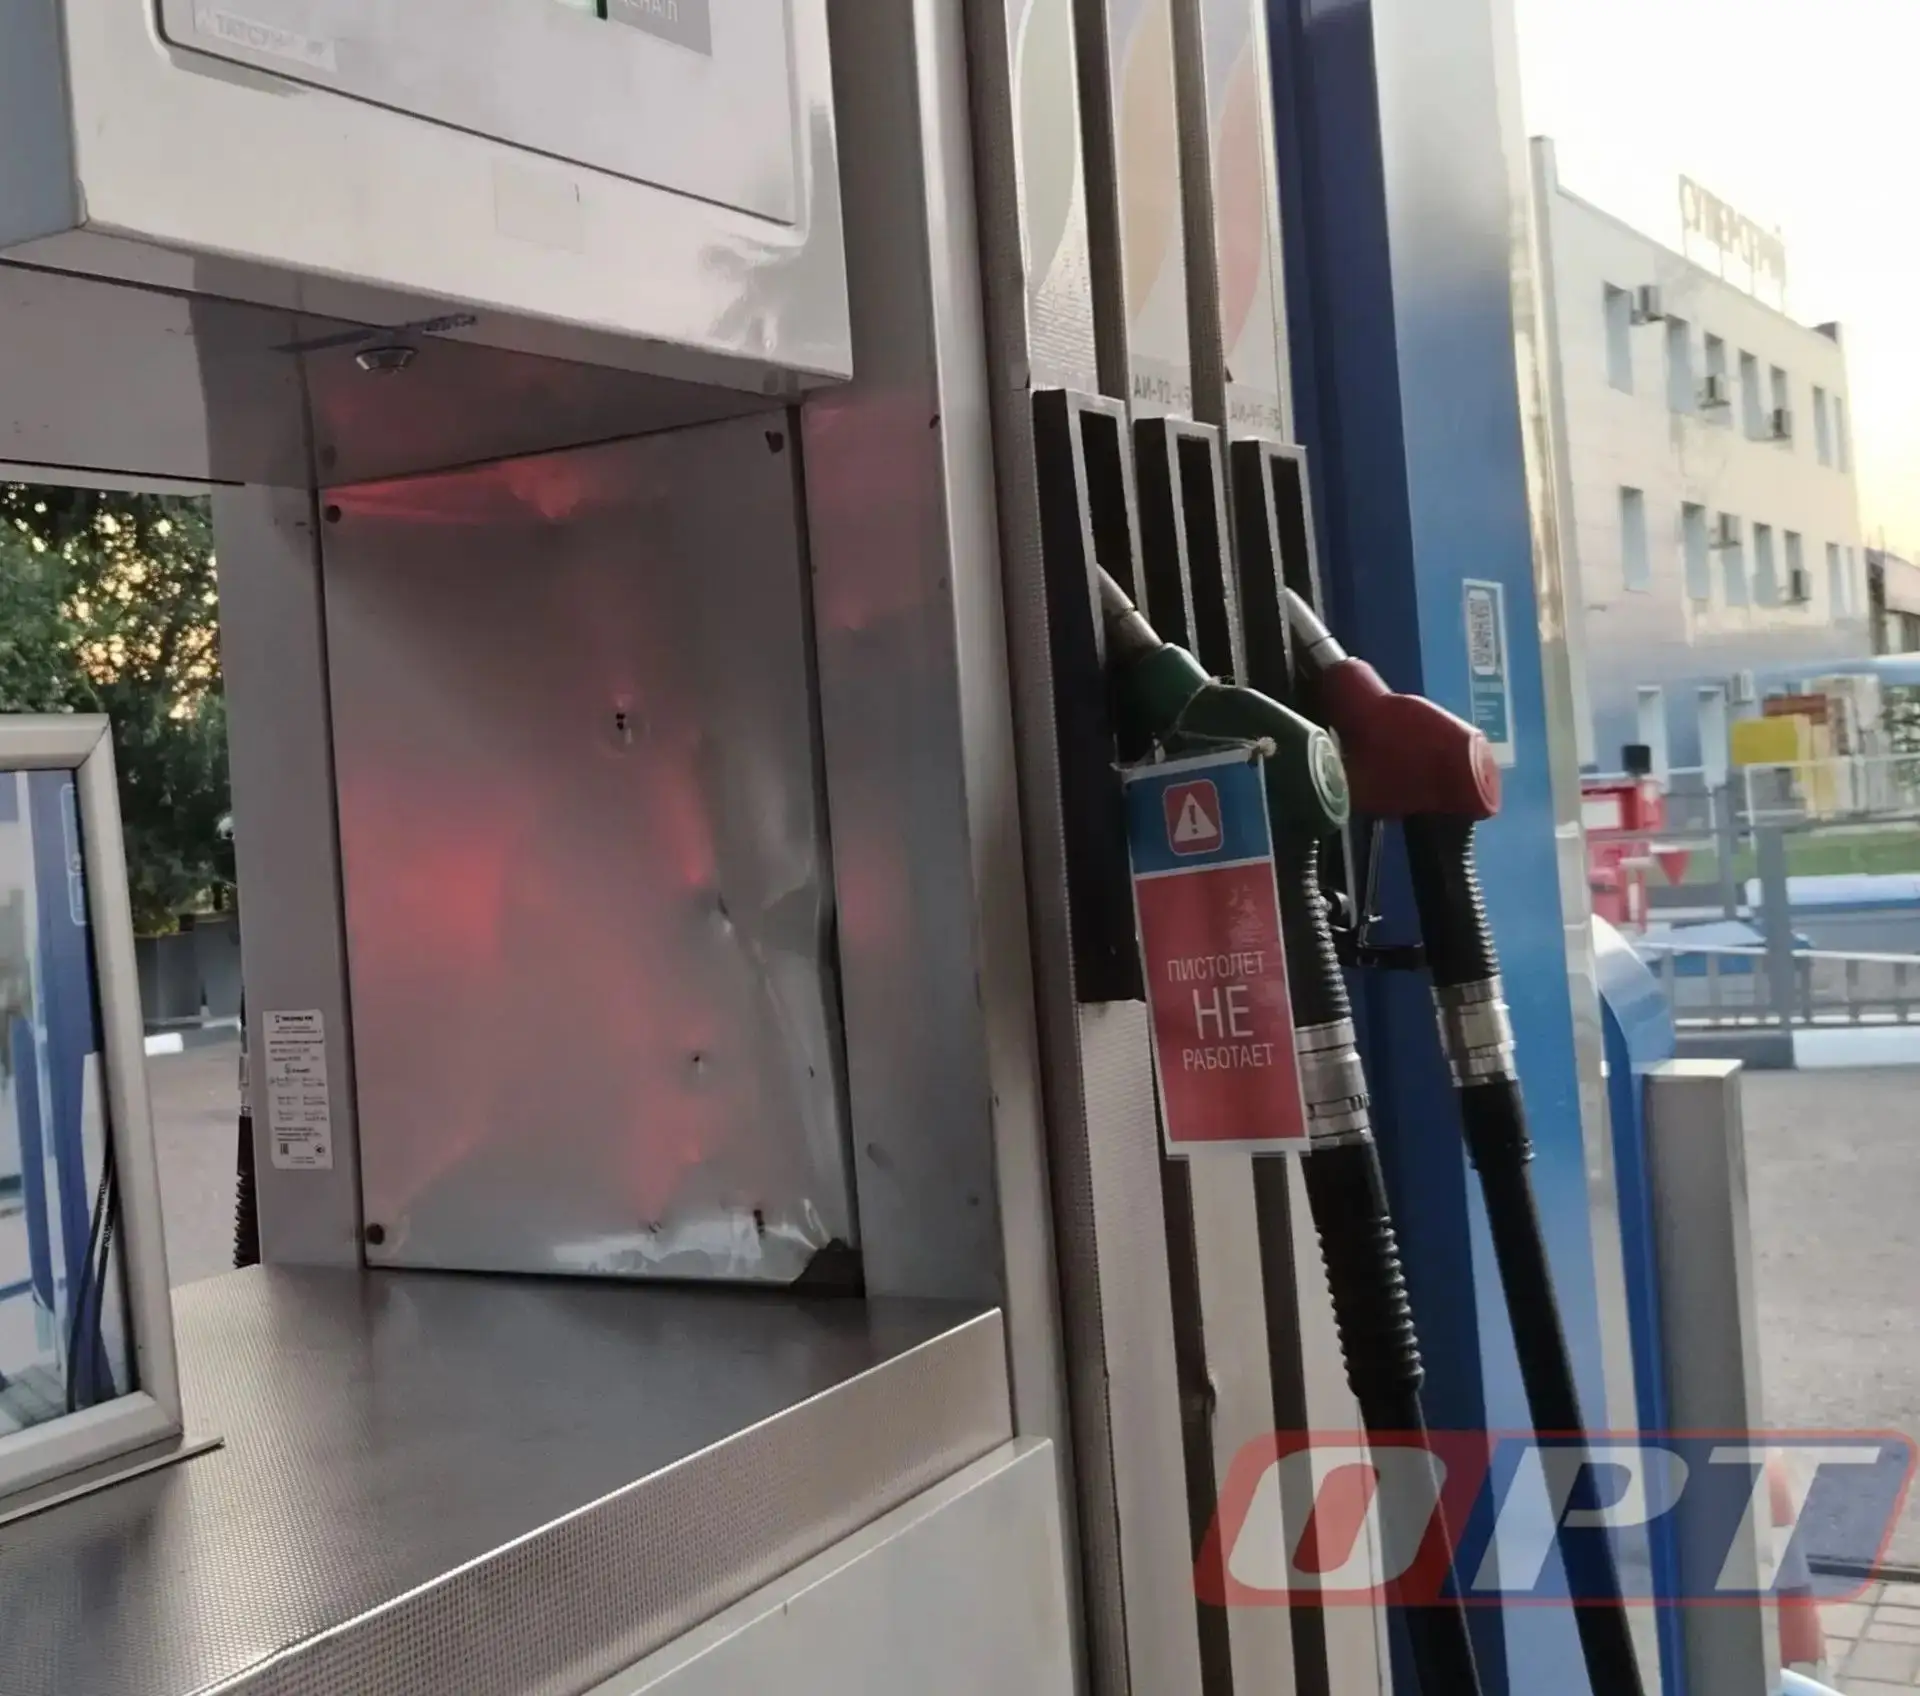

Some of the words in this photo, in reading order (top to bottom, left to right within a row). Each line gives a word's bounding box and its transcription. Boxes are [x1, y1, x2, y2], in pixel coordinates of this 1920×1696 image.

[1167, 951, 1266, 982] ПИСТОЛЕТ
[1192, 985, 1254, 1040] НЕ
[1182, 1043, 1275, 1071] РАБОТАЕТ
